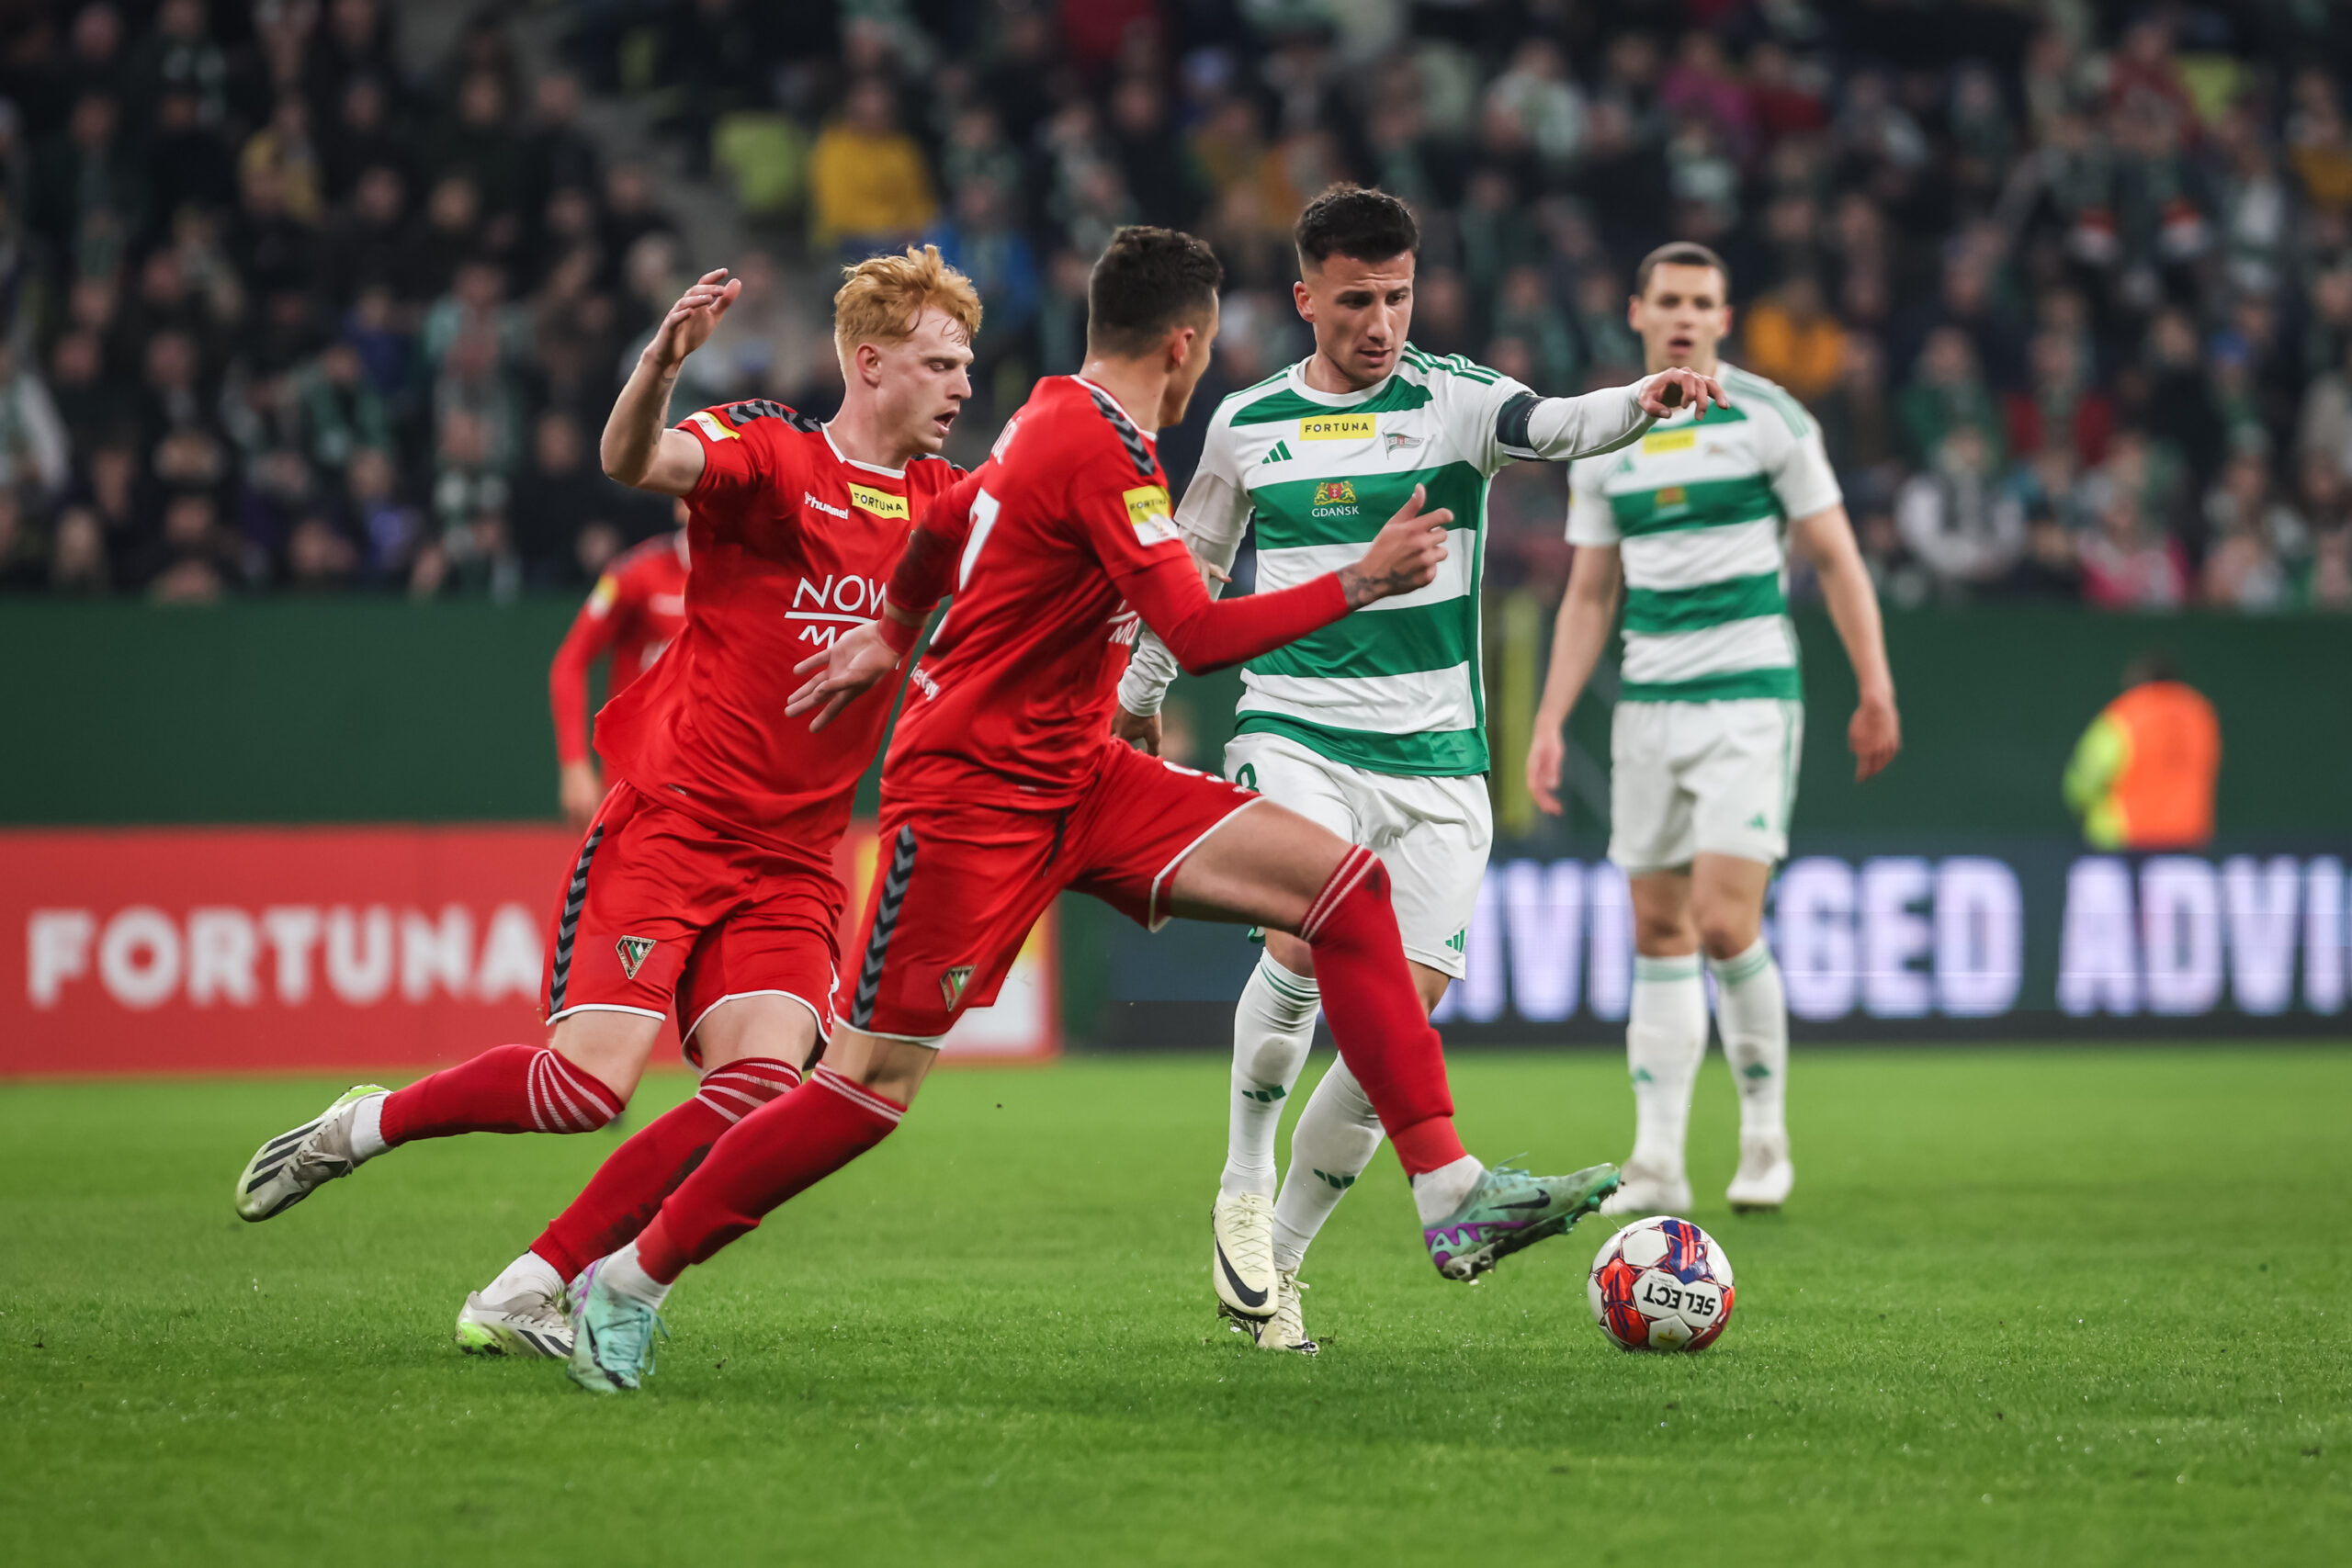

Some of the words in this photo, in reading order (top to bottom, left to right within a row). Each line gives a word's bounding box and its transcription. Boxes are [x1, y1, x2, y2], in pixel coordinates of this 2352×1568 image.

[1305, 423, 1369, 434] FORTUNA
[809, 496, 850, 520] hummel
[854, 492, 904, 512] FORTUNA
[1311, 505, 1360, 518] GDAŃSK
[26, 905, 544, 1009] FORTUNA
[1642, 1282, 1716, 1317] SELECT
